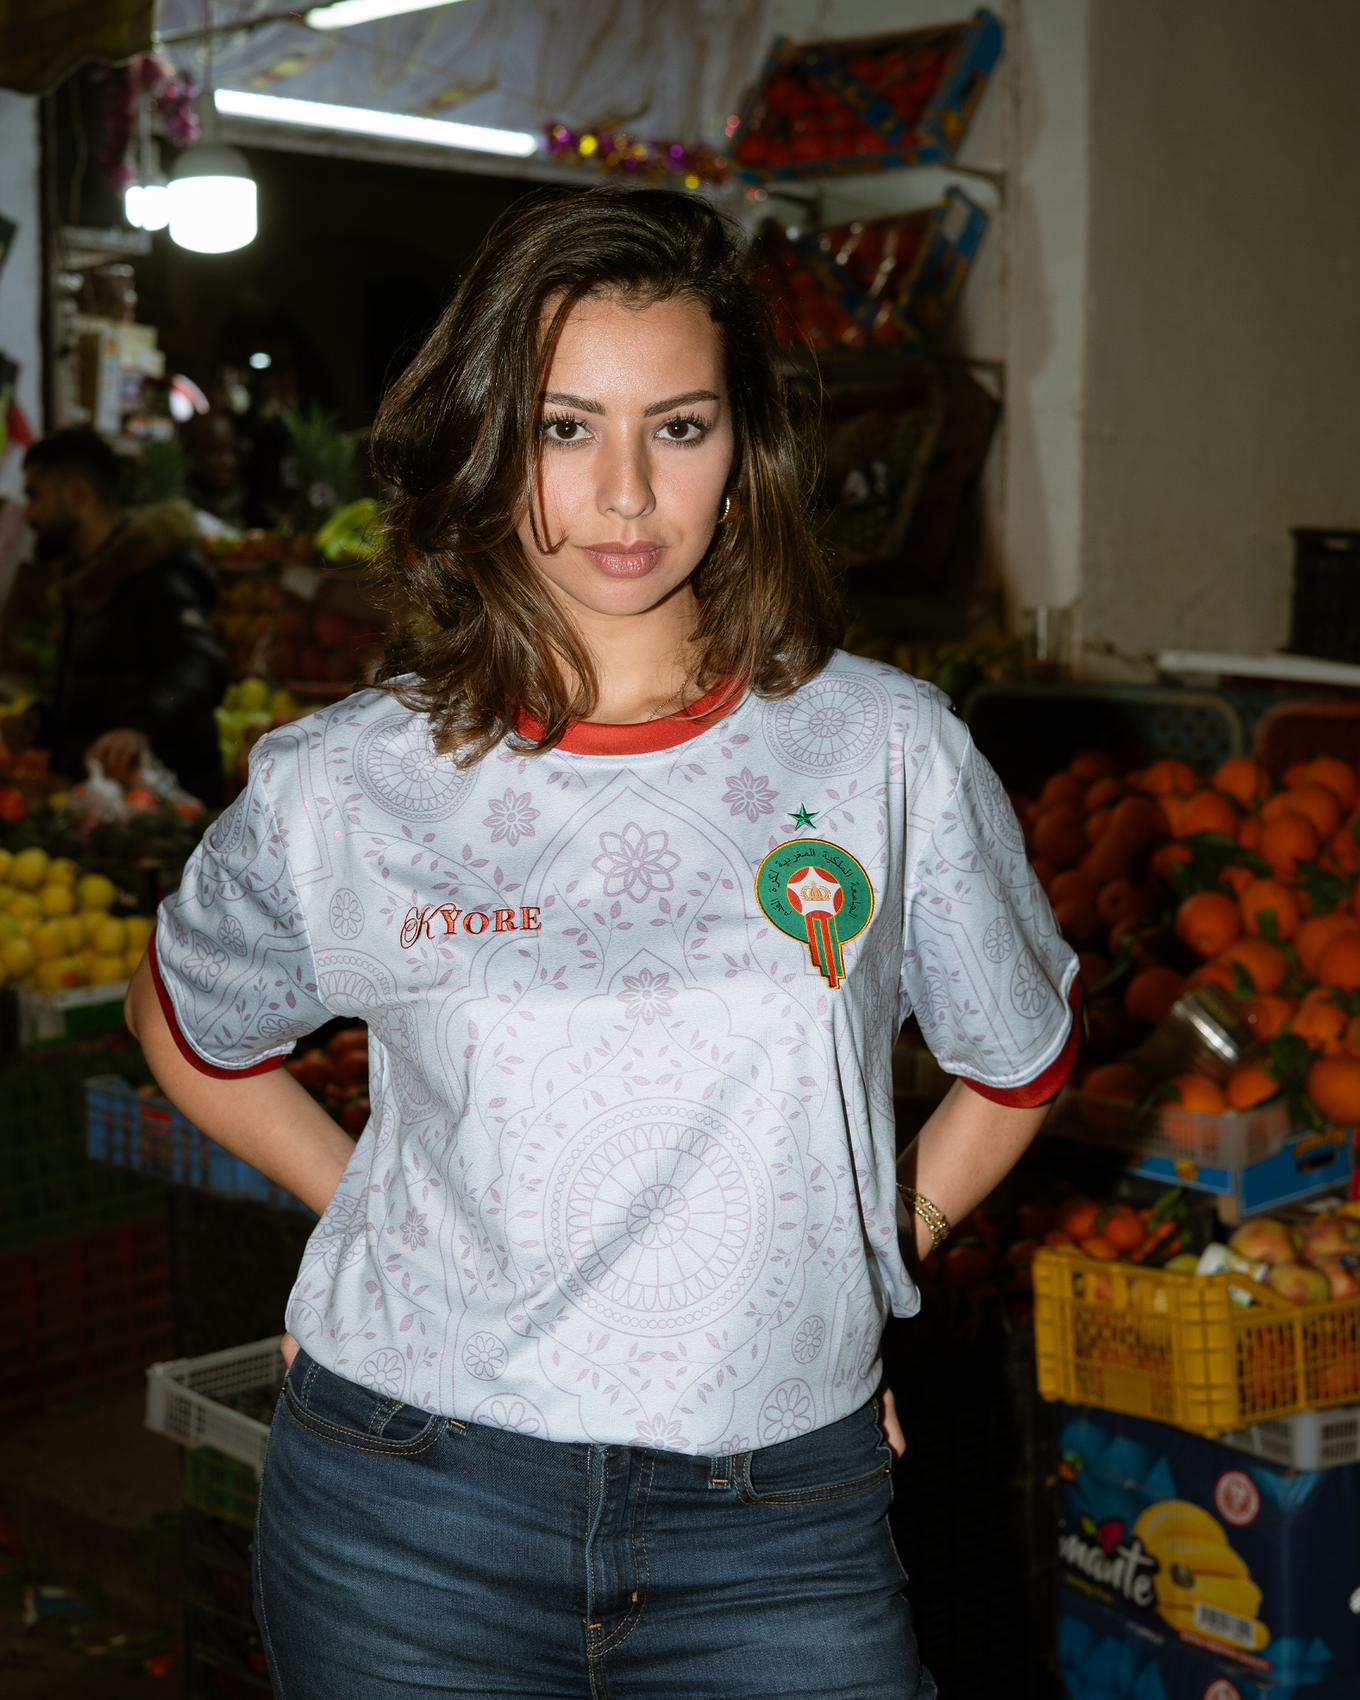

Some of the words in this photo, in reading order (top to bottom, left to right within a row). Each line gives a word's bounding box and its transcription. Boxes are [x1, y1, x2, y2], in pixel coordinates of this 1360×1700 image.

[775, 847, 816, 868] المغربية
[822, 850, 853, 878] الملكية
[768, 869, 780, 893] لكرة
[770, 898, 792, 916] القدم
[848, 881, 861, 919] الجامعة
[400, 902, 542, 950] KYORE
